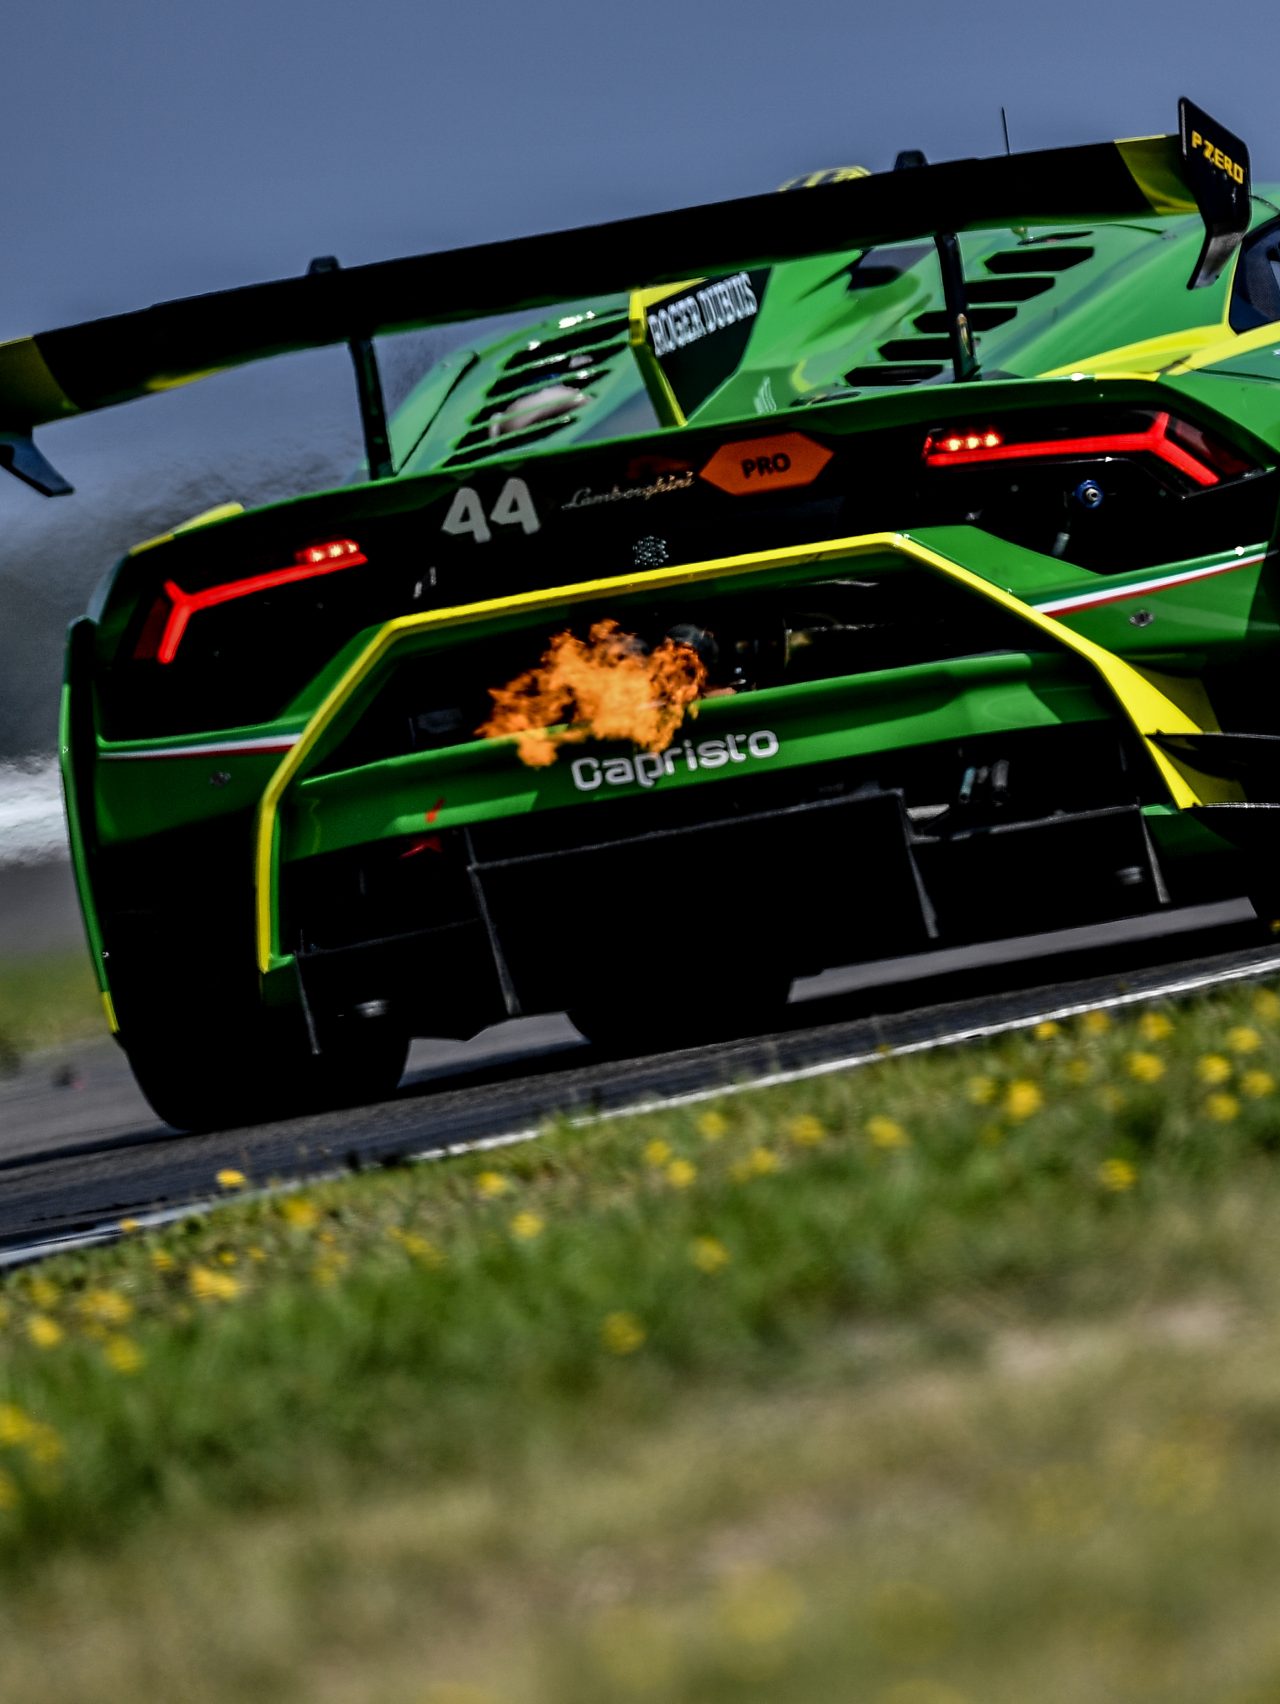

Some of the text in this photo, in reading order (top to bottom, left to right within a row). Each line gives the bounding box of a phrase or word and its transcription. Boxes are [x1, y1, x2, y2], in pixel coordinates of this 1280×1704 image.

[1191, 130, 1245, 184] P ZERO
[648, 295, 706, 357] ROGER
[561, 471, 695, 511] Lamborghini
[741, 452, 791, 480] PRO
[441, 476, 541, 543] 44
[571, 730, 780, 792] Capristo
